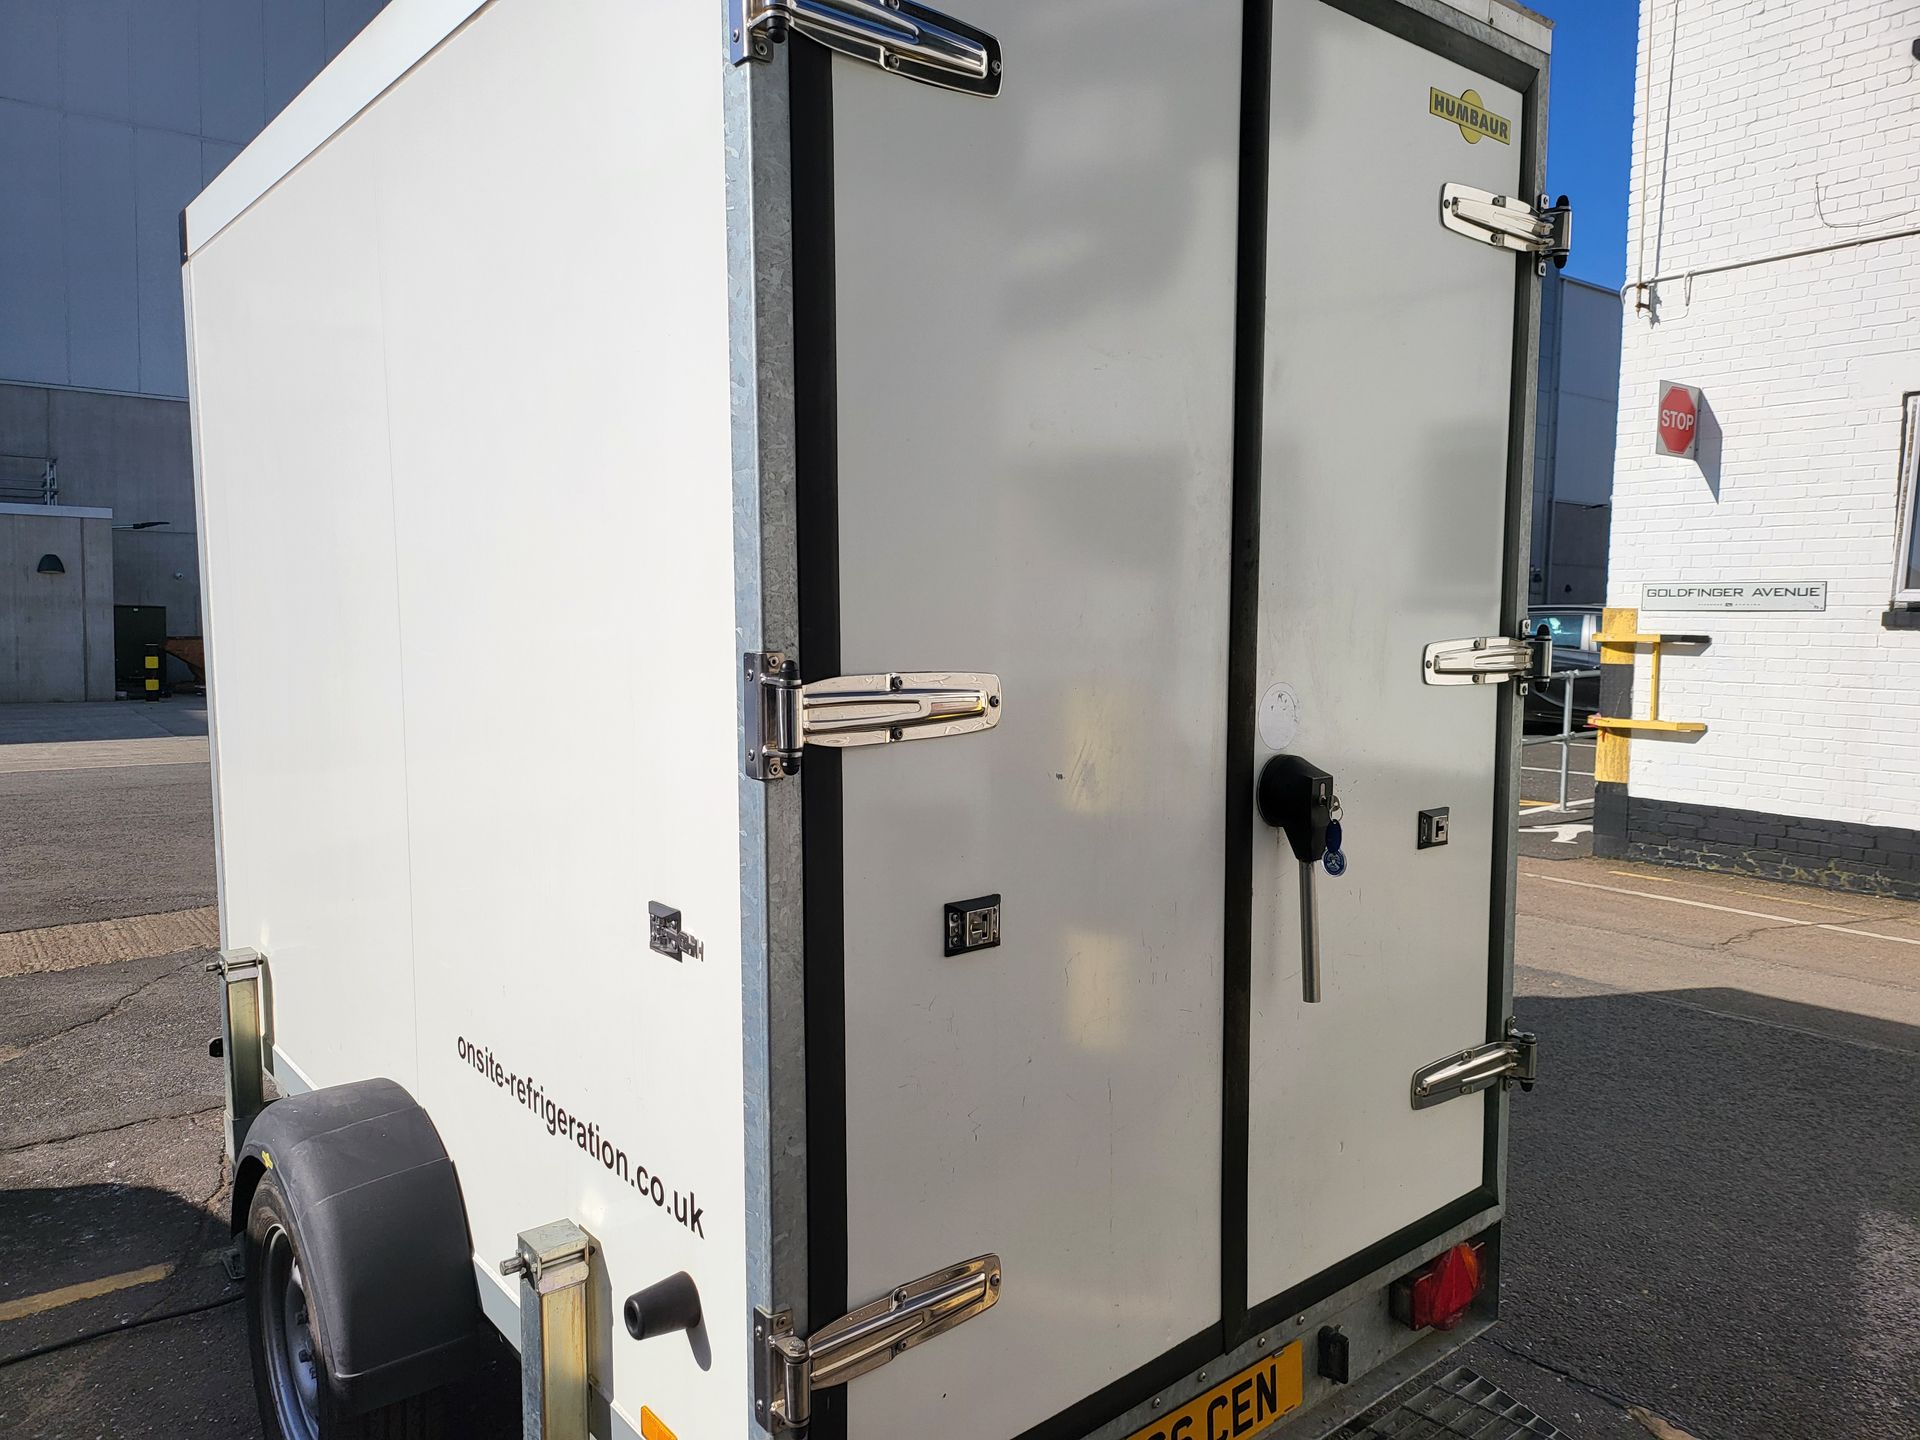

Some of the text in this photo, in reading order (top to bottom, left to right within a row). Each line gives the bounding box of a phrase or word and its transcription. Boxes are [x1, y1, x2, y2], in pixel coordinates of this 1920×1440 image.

[1434, 94, 1508, 139] HUMBAUR
[1661, 409, 1694, 431] STOP
[1647, 587, 1820, 597] GOLDFINGER AVENUE
[457, 1036, 705, 1239] onsite-refrigeration.co.uk
[1207, 1364, 1277, 1440] CEN
